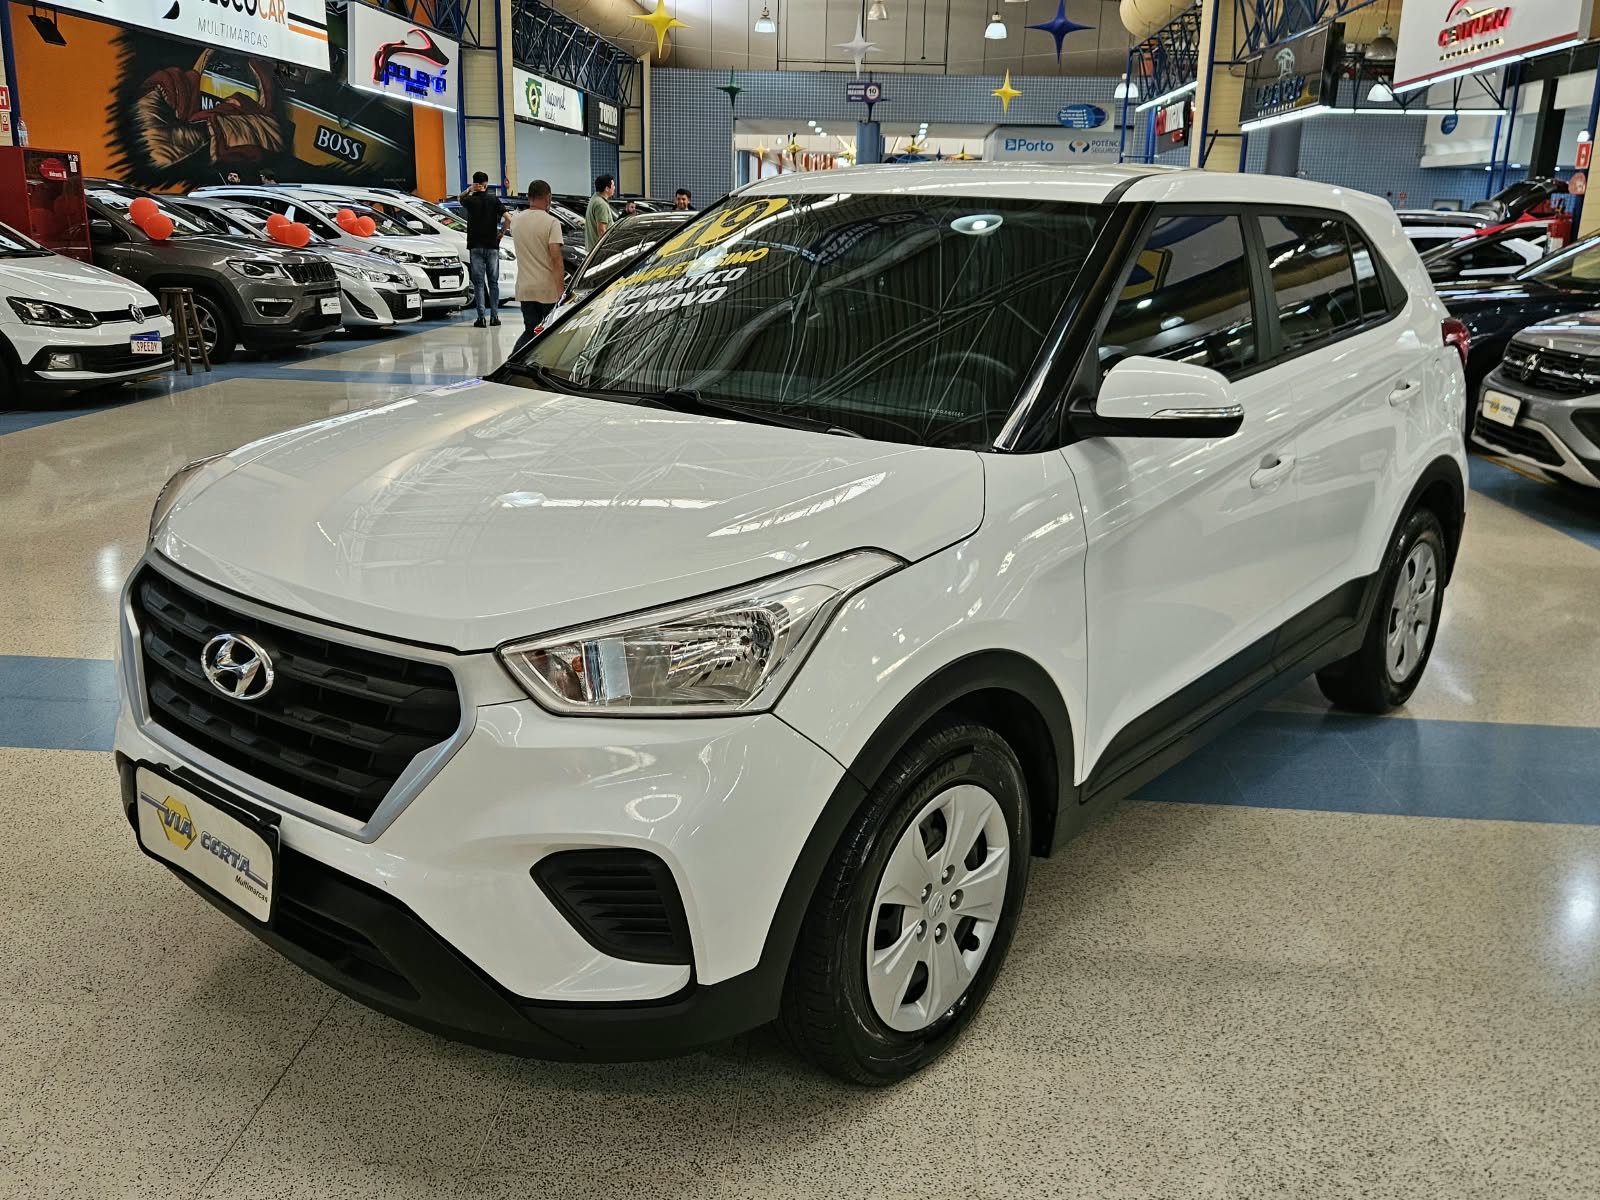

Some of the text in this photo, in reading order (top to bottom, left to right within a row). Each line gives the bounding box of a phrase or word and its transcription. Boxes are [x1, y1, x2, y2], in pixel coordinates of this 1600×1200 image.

[197, 17, 269, 48] MULTIMARCAS
[1438, 6, 1511, 47] CENTURY
[317, 127, 363, 160] BOSS
[1018, 139, 1054, 152] Porto
[1091, 139, 1121, 148] POTÊNC
[635, 286, 728, 315] NOVO
[136, 341, 158, 352] SPEEDY
[164, 809, 251, 876] VIA CERTA
[235, 874, 269, 904] Multimarcas
